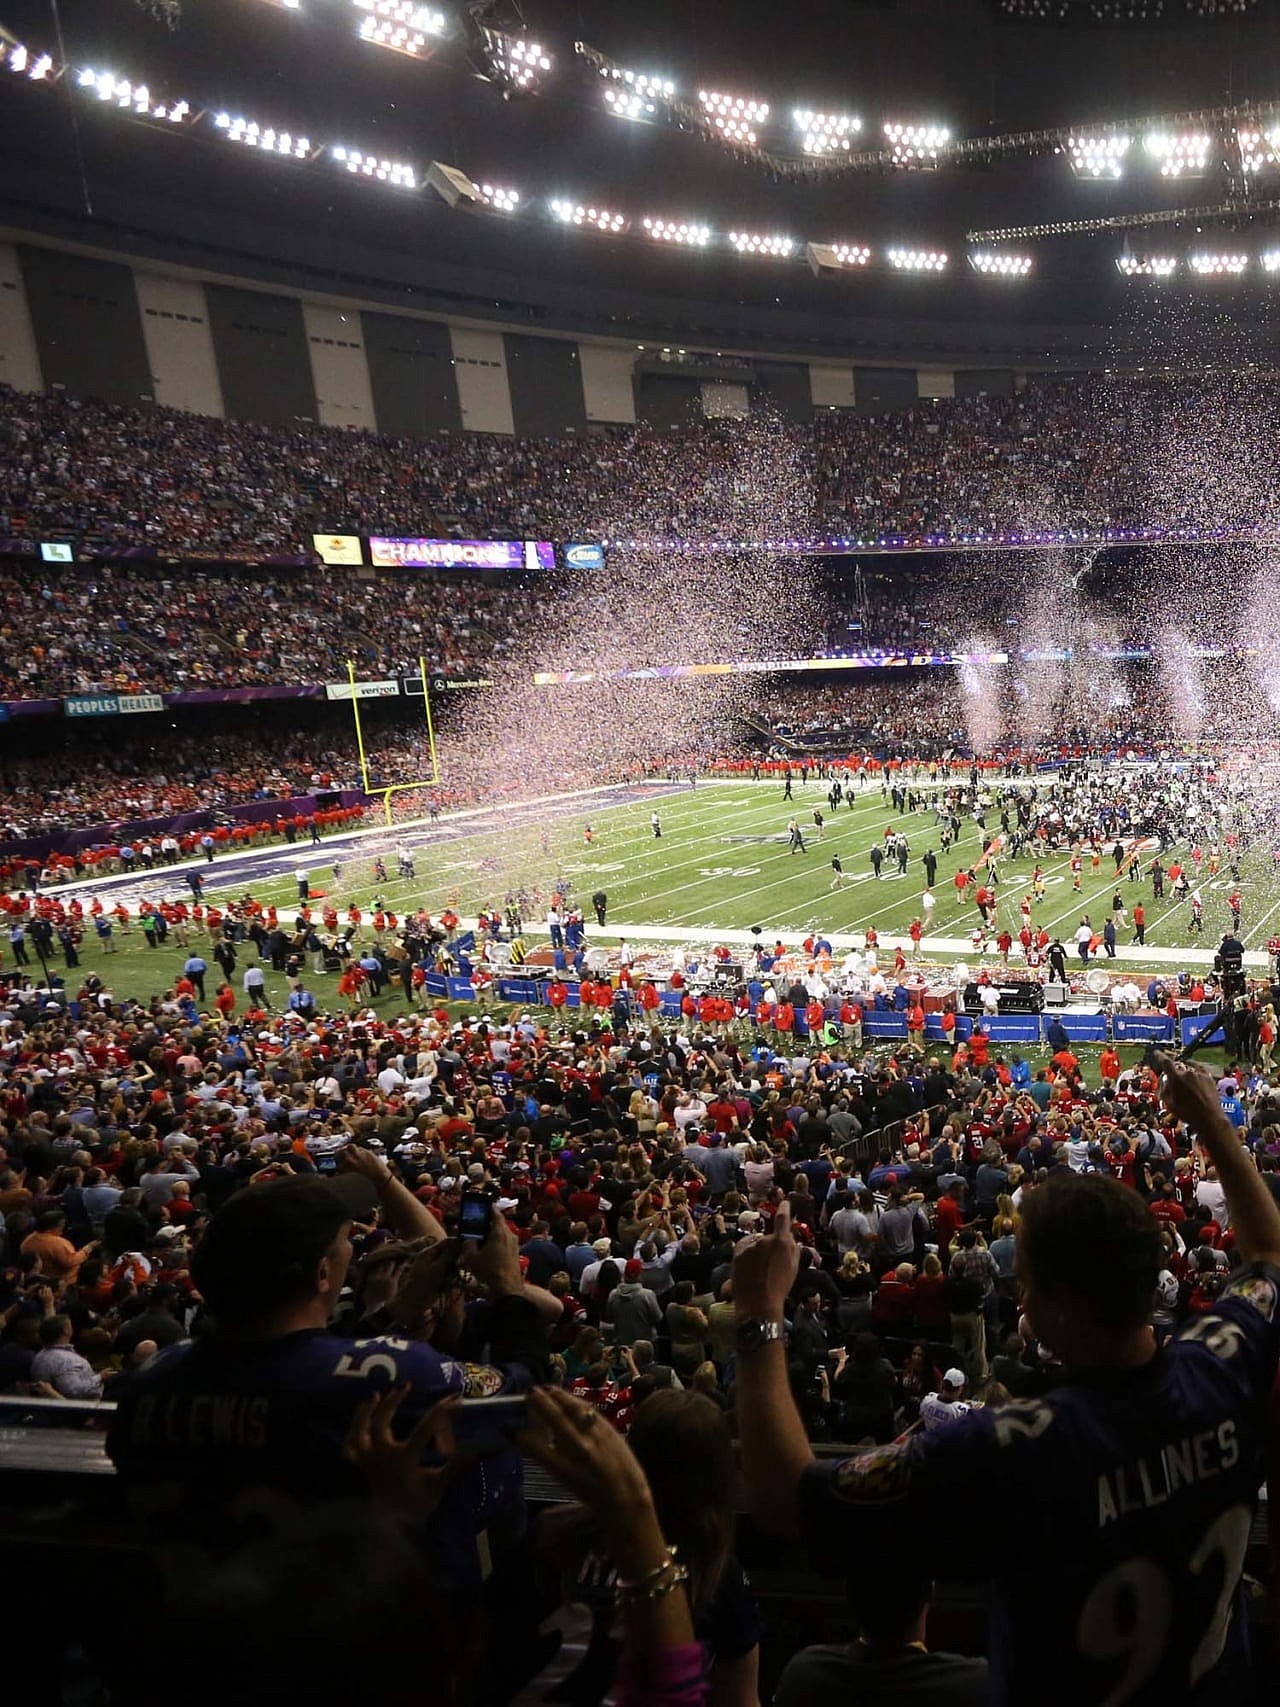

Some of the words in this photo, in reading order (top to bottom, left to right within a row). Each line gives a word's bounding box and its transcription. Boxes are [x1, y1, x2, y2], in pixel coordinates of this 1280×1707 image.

[372, 541, 512, 563] CHAMPIONS
[361, 686, 396, 695] verizon
[68, 699, 118, 714] PEOPLES
[119, 696, 163, 712] HEALTH
[971, 1136, 984, 1149] 21
[1115, 1165, 1124, 1179] 7
[166, 1396, 270, 1448] LEWIS
